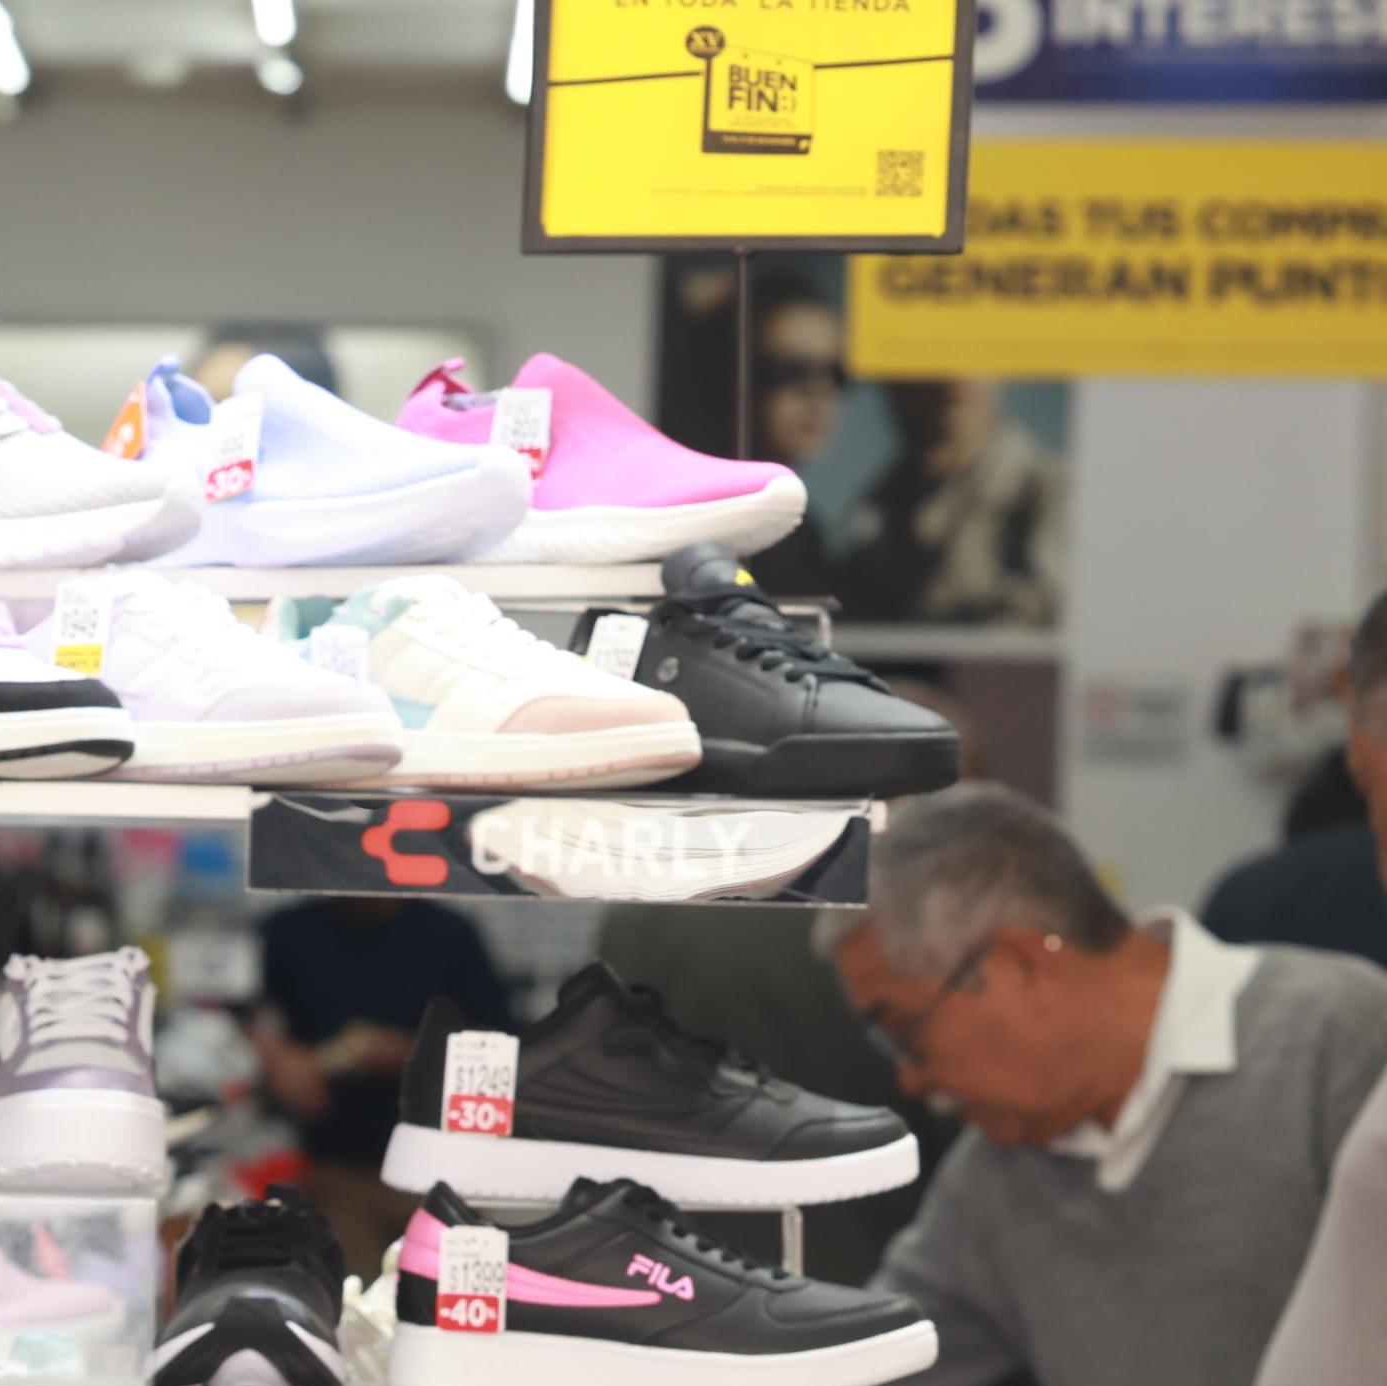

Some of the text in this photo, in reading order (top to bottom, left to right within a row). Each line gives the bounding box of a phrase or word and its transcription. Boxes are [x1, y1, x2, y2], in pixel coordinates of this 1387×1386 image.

[728, 63, 798, 92] BUEN
[728, 87, 779, 113] FIN
[881, 256, 1190, 304] GENERAN
[470, 815, 752, 882] CHARLY
[448, 1101, 509, 1131] -30%
[449, 1260, 505, 1295] $1399
[626, 1252, 696, 1302] FILA
[439, 1298, 499, 1330] -40%
